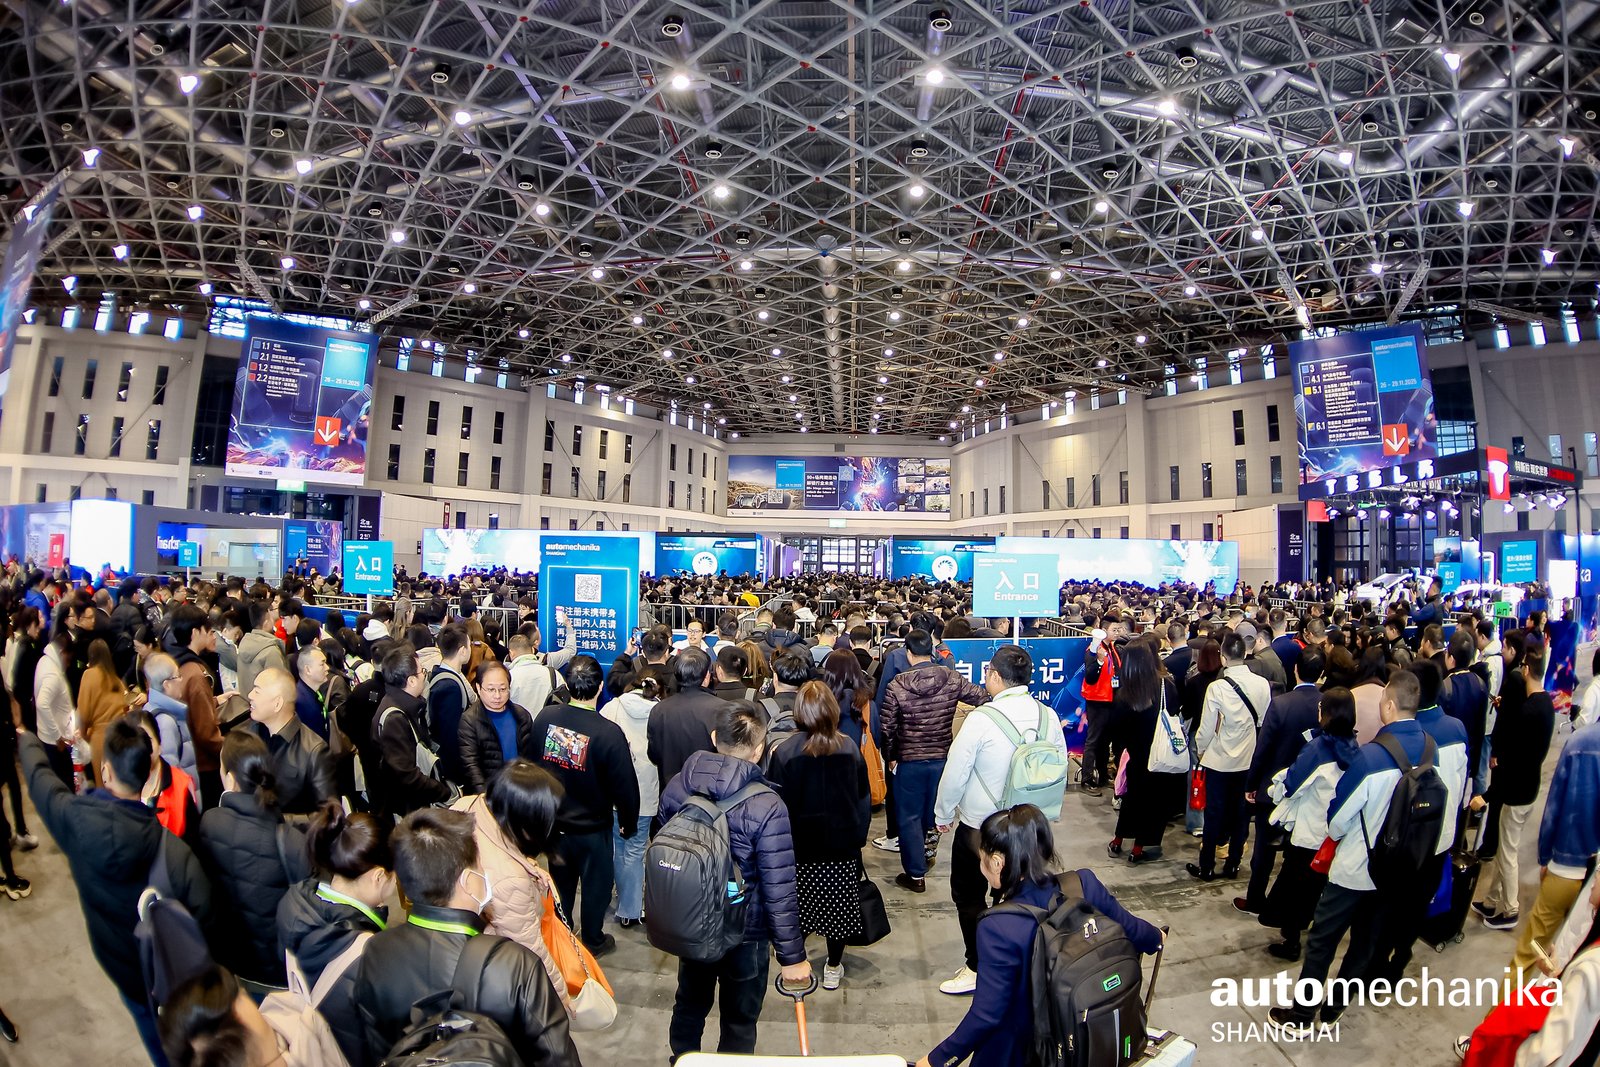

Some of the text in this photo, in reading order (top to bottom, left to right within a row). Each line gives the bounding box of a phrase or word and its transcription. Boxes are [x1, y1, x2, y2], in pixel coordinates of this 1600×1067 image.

[262, 342, 270, 350] 1.1
[260, 352, 270, 361] 2.1
[258, 363, 269, 372] 1.2
[1310, 364, 1315, 373] 3
[256, 373, 269, 383] 2.2
[1311, 375, 1320, 383] 4.1
[1312, 386, 1322, 394] 5.1
[1316, 422, 1326, 430] 6.1
[355, 555, 382, 572] 入口
[355, 572, 381, 582] Entrance
[995, 570, 1039, 590] 入口
[994, 592, 1039, 600] Entrance
[556, 606, 616, 618] 注册未携带身
[557, 628, 616, 640] 再扫码实名认
[557, 638, 616, 651] 证二维码入场
[954, 658, 1064, 684] 自记
